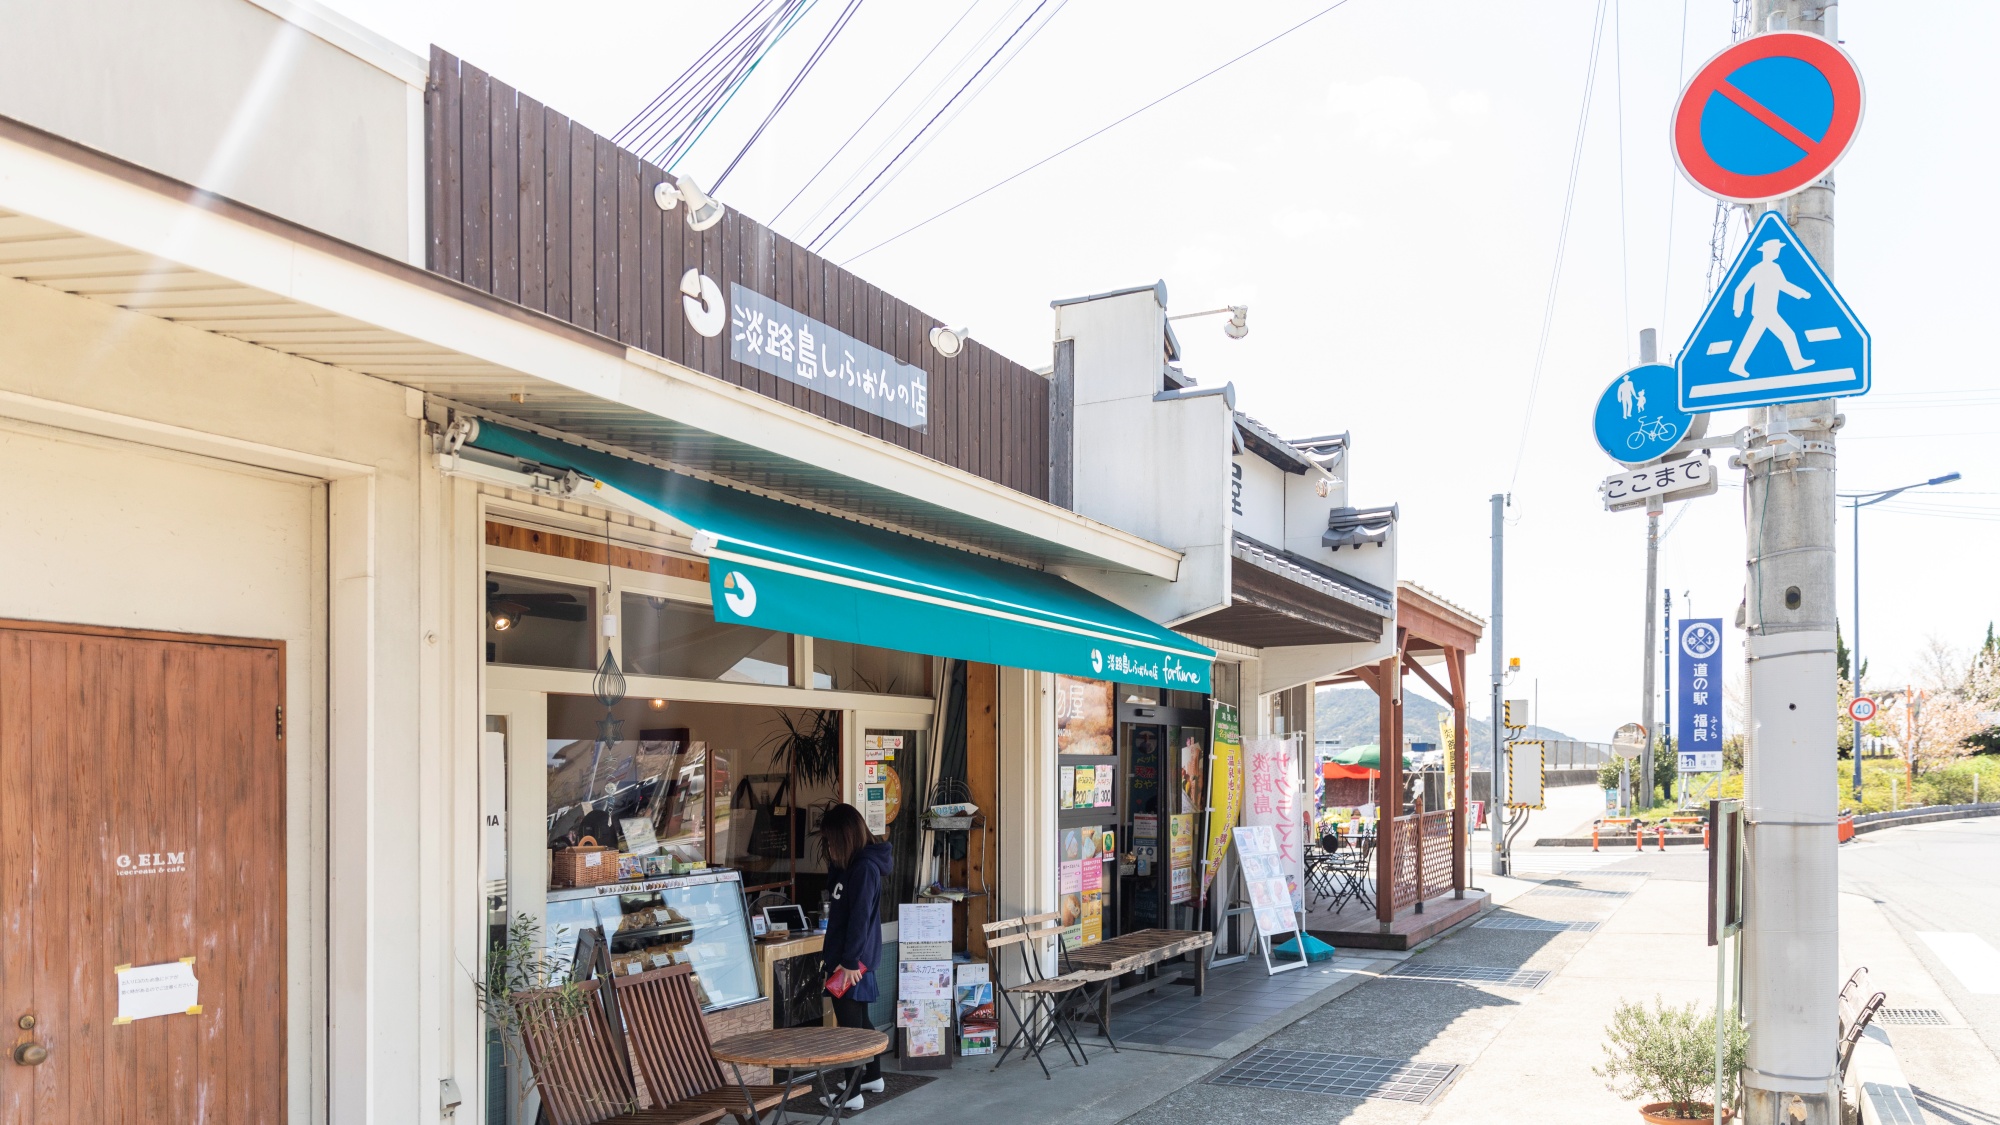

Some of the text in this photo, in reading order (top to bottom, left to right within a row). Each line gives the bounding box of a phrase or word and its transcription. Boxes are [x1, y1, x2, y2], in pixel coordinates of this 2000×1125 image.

[733, 303, 926, 419] 淡路島しふぉんの店
[1608, 460, 1703, 498] ここまで
[1162, 655, 1200, 684] fortune
[1693, 663, 1708, 742] 道の駅 福良
[1855, 703, 1871, 715] 40
[1710, 716, 1718, 740] ふくら
[117, 852, 185, 870] G.ELM
[117, 868, 156, 876] icecream
